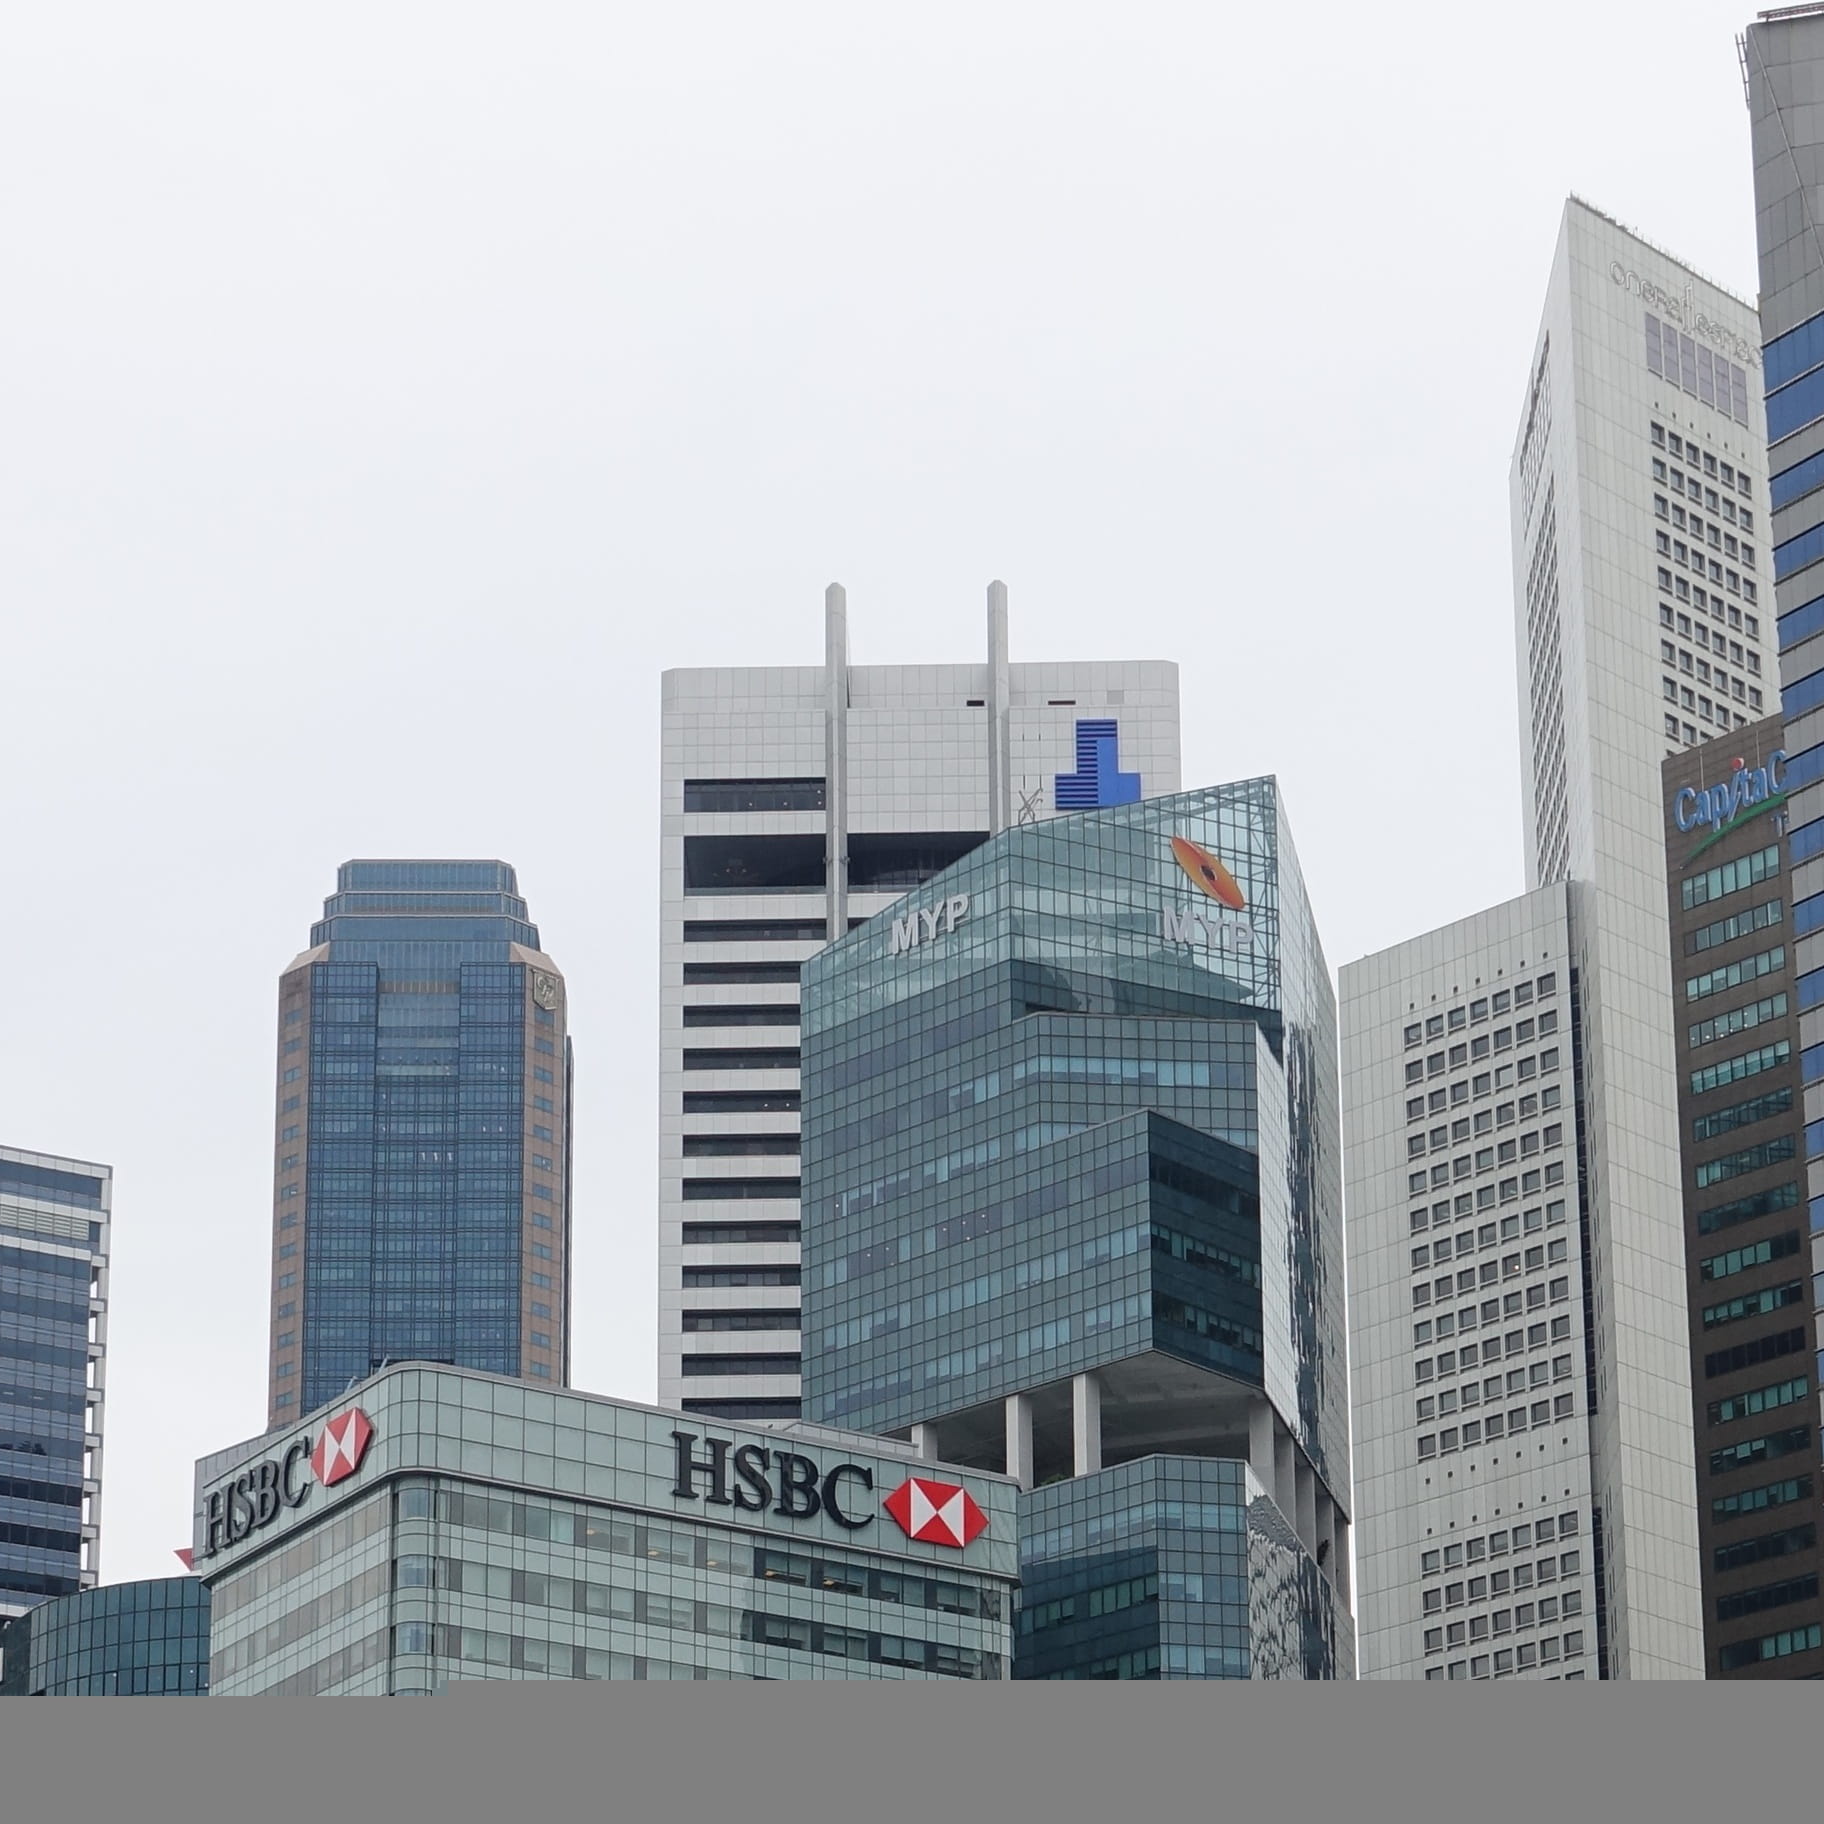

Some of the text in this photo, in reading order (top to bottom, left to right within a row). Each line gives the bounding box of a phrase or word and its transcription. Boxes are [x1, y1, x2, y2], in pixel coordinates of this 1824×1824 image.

[891, 893, 969, 955] MYP
[1162, 904, 1254, 953] MYP
[202, 1435, 313, 1558] HSBC
[671, 1430, 876, 1530] HSBC
